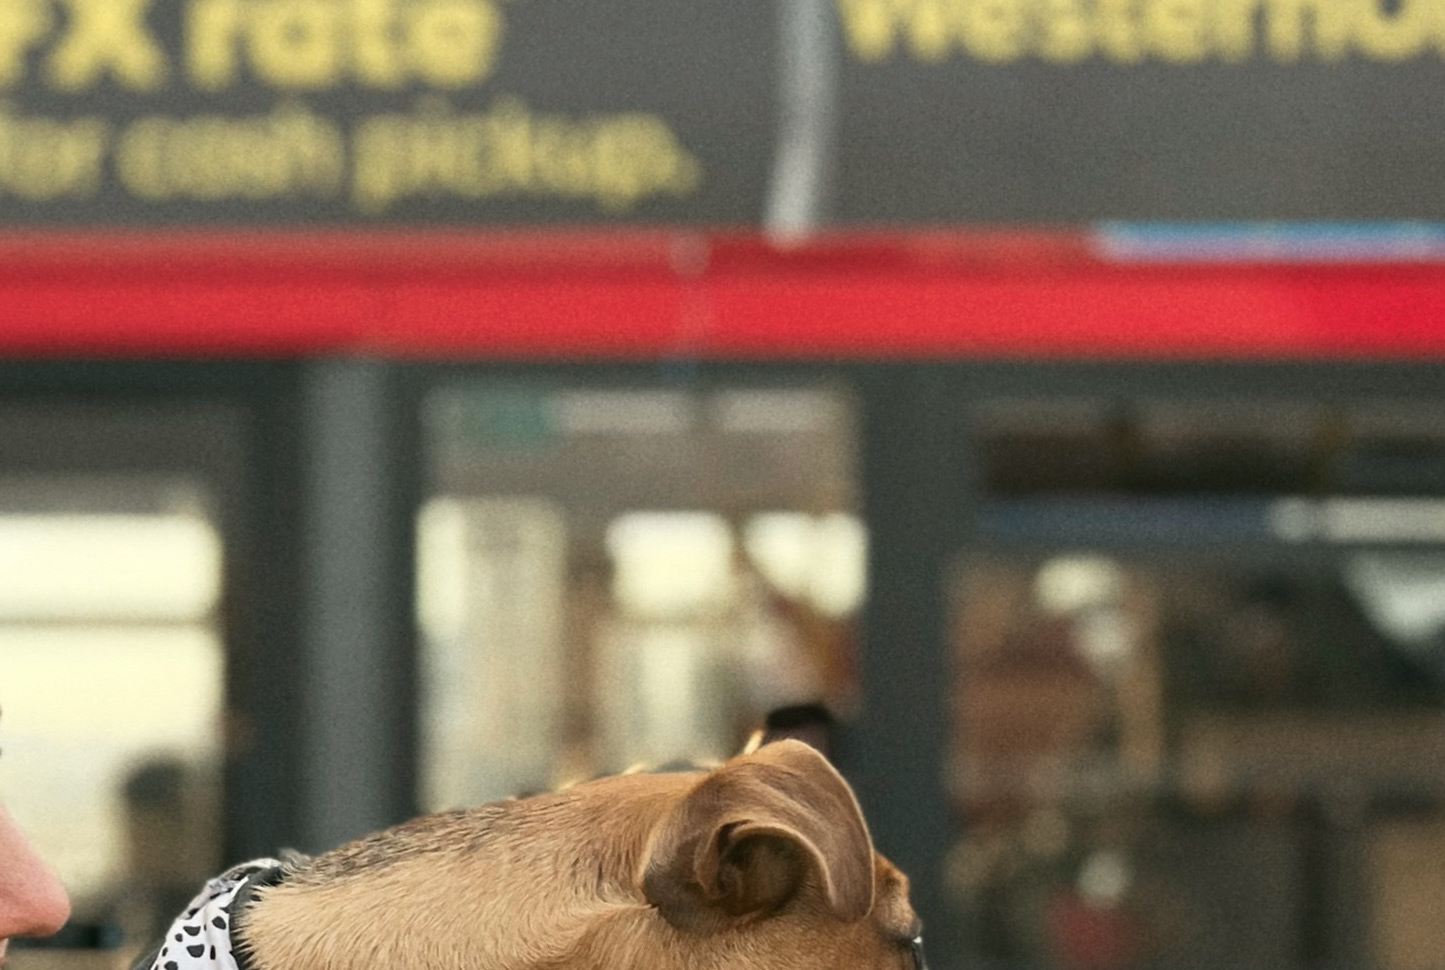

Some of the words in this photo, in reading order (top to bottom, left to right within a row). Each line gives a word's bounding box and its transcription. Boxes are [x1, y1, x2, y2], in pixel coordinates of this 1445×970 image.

[180, 0, 504, 90] rate
[118, 102, 344, 196] cash
[356, 98, 700, 208] pickup.
